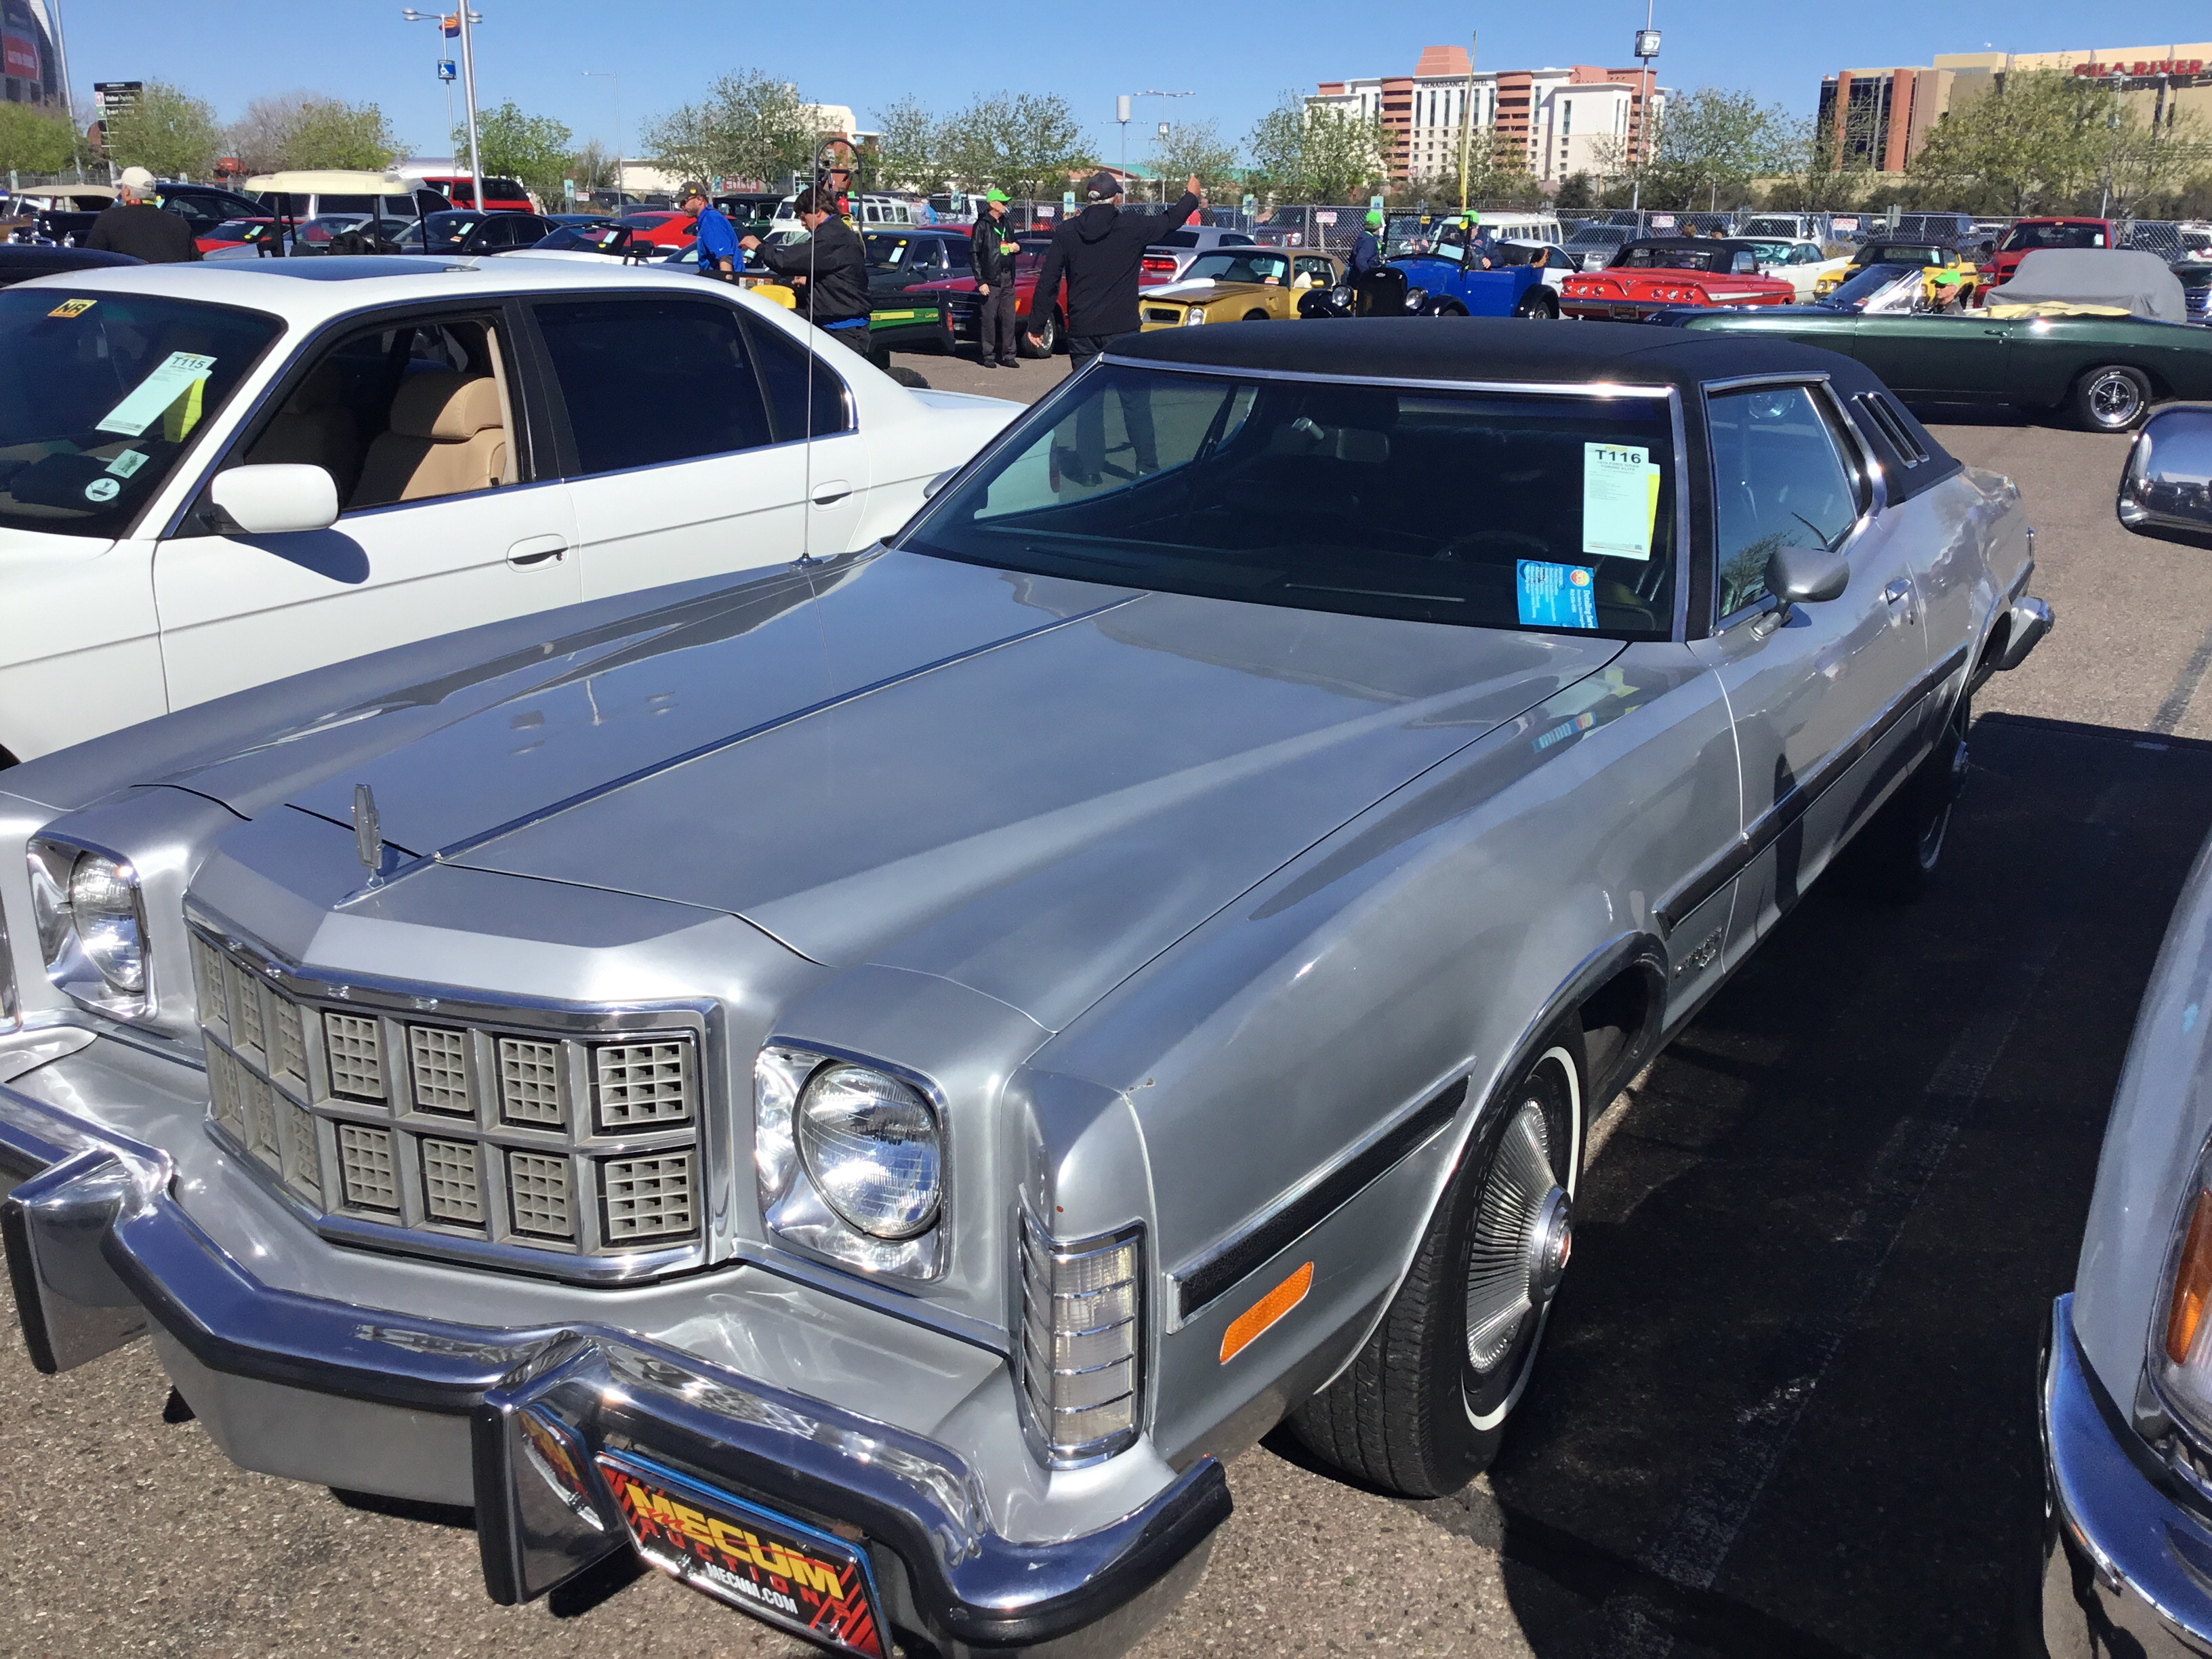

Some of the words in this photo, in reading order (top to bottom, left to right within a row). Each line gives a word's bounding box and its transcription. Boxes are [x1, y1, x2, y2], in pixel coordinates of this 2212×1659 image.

[1643, 37, 1660, 49] 57
[2074, 62, 2125, 77] GILA
[2133, 60, 2203, 76] RIVER
[1422, 80, 1467, 89] RENAISSANCE
[1471, 79, 1489, 87] OTEL
[54, 303, 88, 314] NR
[172, 356, 206, 369] T115
[1595, 449, 1641, 464] T116
[1582, 590, 1593, 615] Detailing
[625, 1483, 844, 1600] MECUM
[639, 1518, 853, 1618] AUCTIONS
[705, 1561, 798, 1614] MECUM.COM
